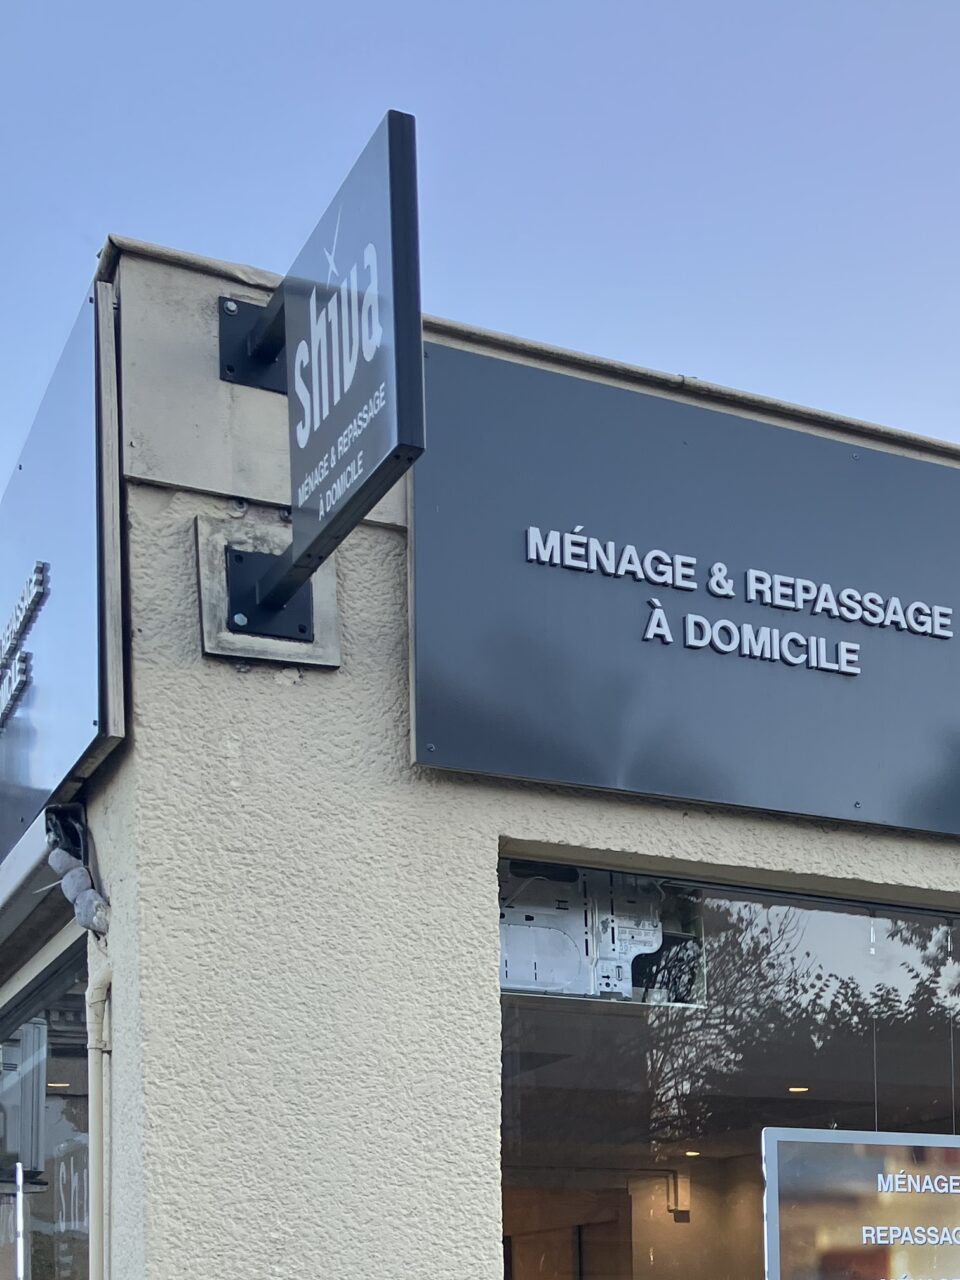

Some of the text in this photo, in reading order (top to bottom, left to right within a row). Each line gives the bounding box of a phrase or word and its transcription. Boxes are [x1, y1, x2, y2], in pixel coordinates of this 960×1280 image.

[294, 242, 383, 449] shiva
[297, 381, 387, 508] MÉNAGE & REPASSAGE
[318, 449, 364, 521] À DOMICILE
[526, 525, 953, 638] MÉNAGE & REPASSAGE
[644, 598, 861, 675] À DOMICILE
[877, 1171, 960, 1194] MÉNAGE
